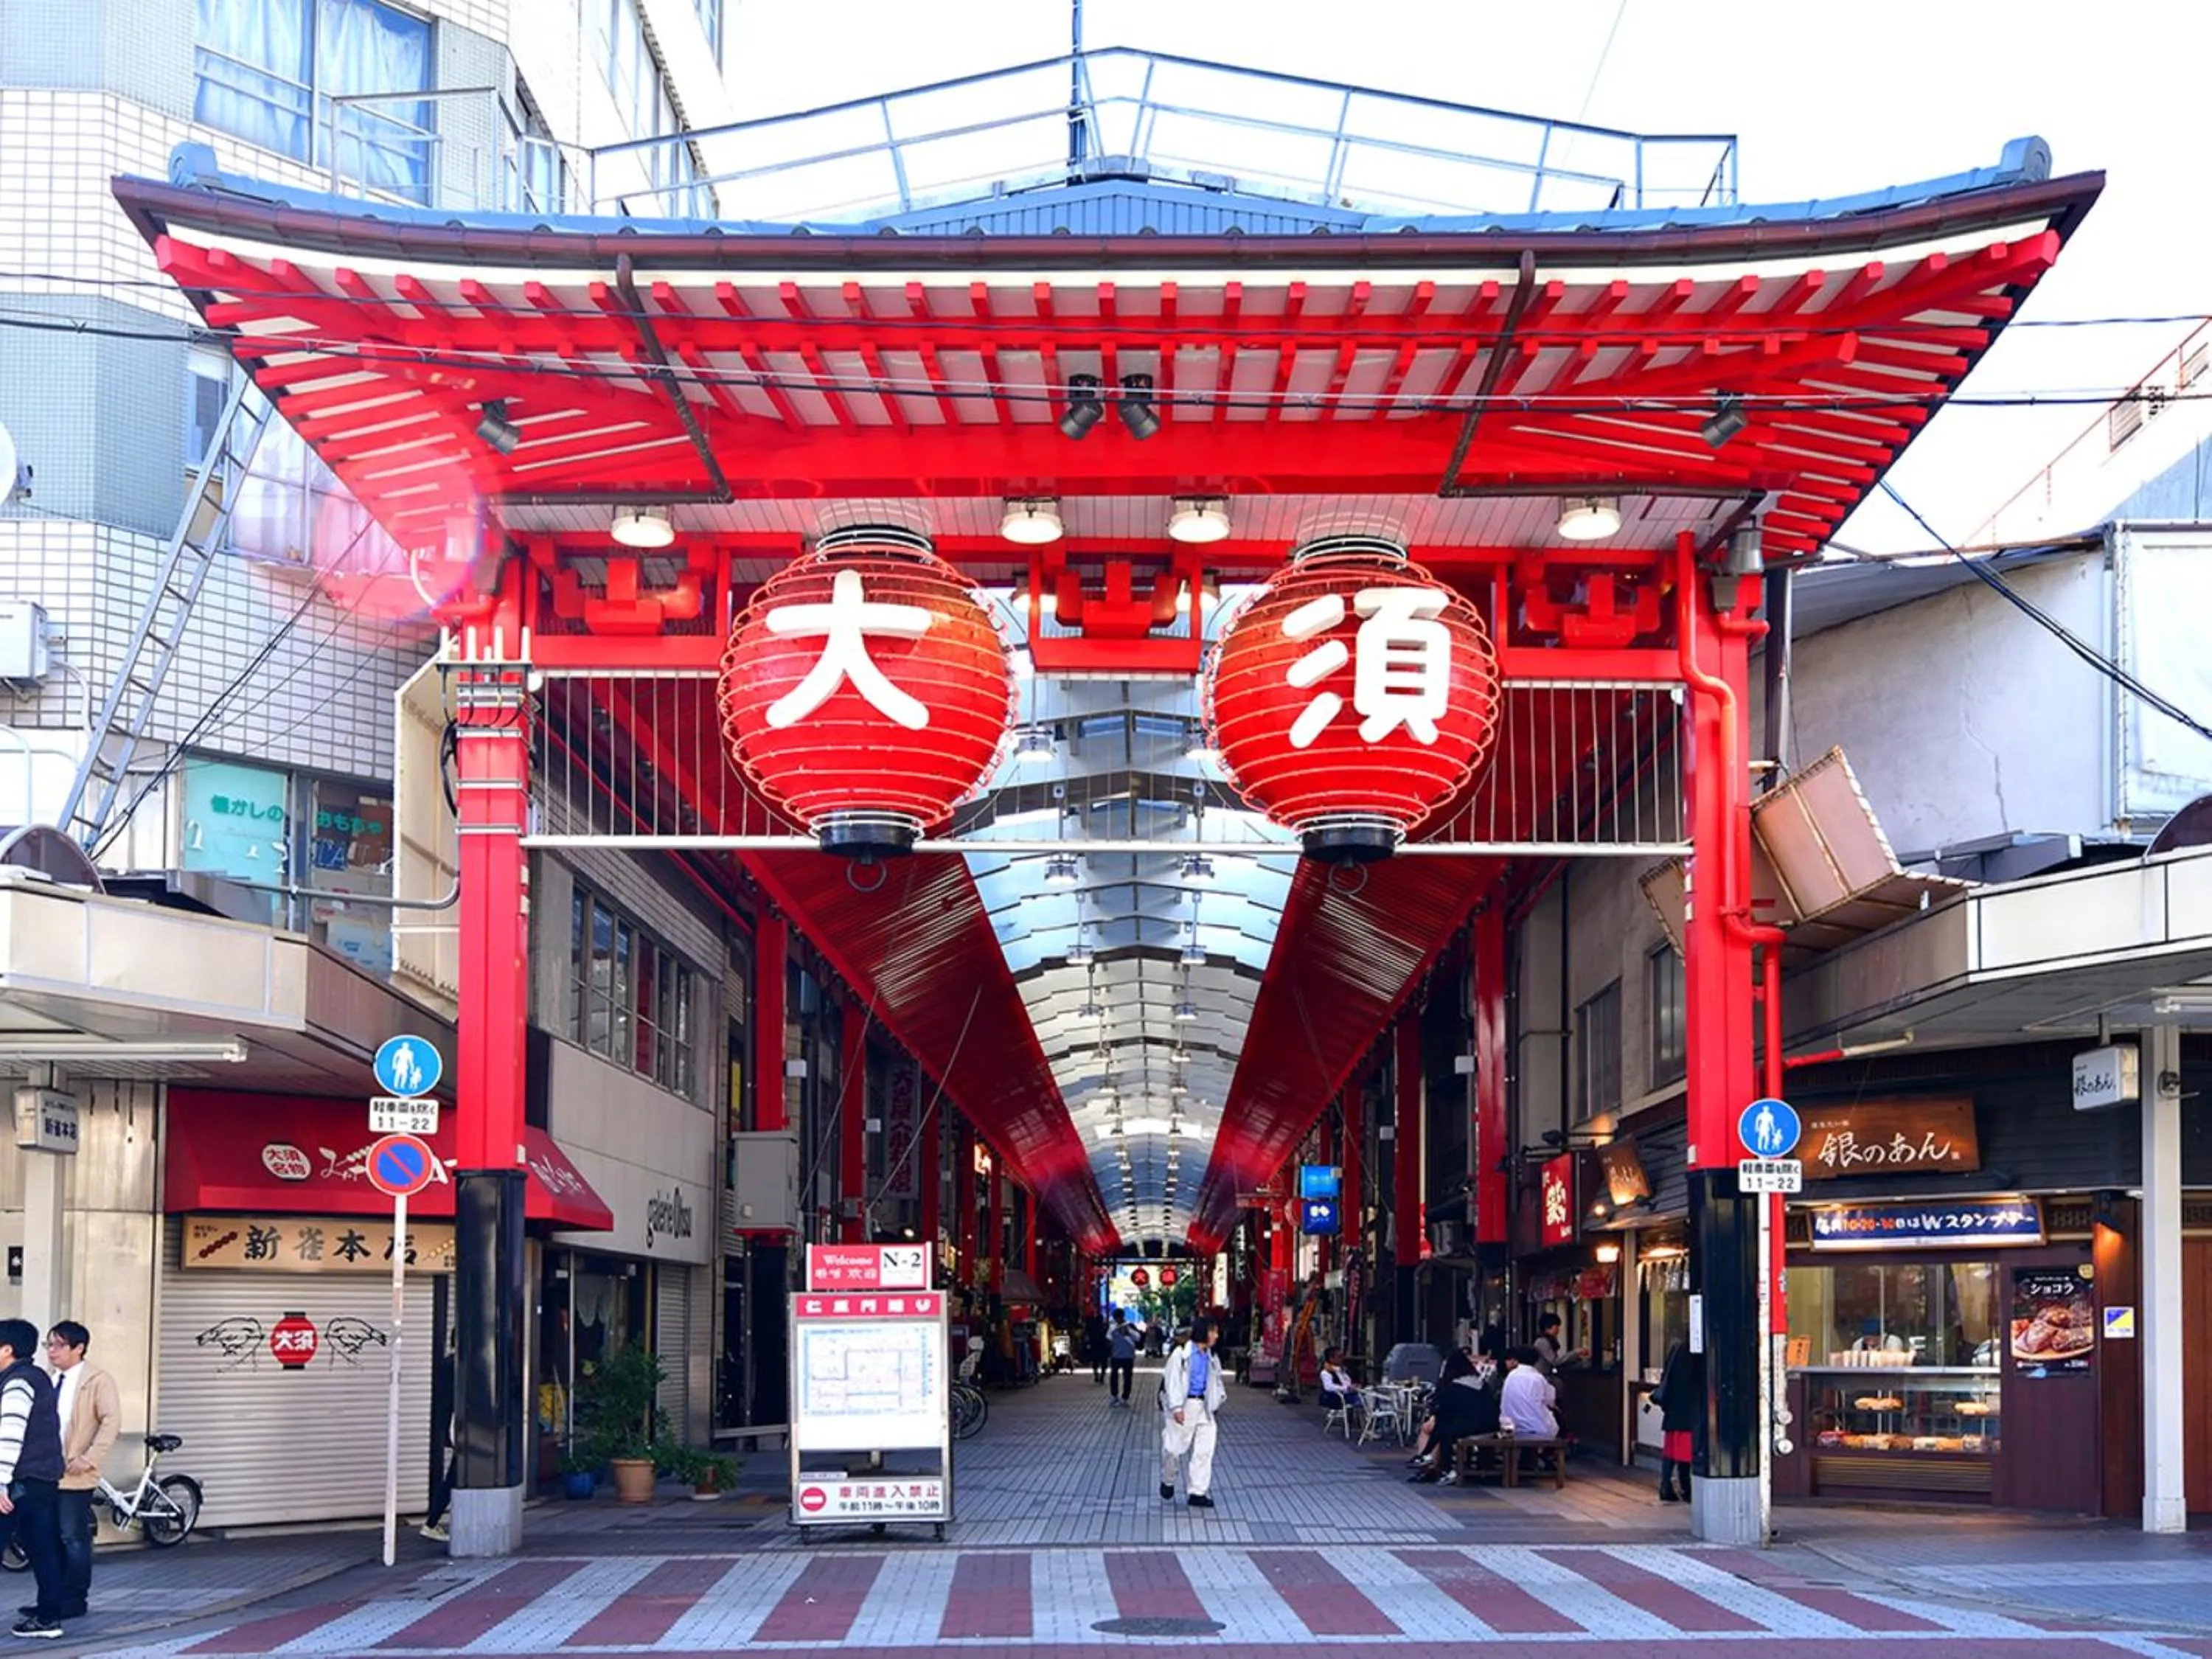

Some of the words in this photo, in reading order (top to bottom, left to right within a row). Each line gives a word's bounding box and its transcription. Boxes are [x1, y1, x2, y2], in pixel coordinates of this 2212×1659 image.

[765, 570, 931, 729] 大
[1282, 588, 1450, 747] 須
[1818, 1132, 1951, 1169] 銀のあん
[823, 1254, 874, 1266] Welcome
[275, 1329, 315, 1351] 大須
